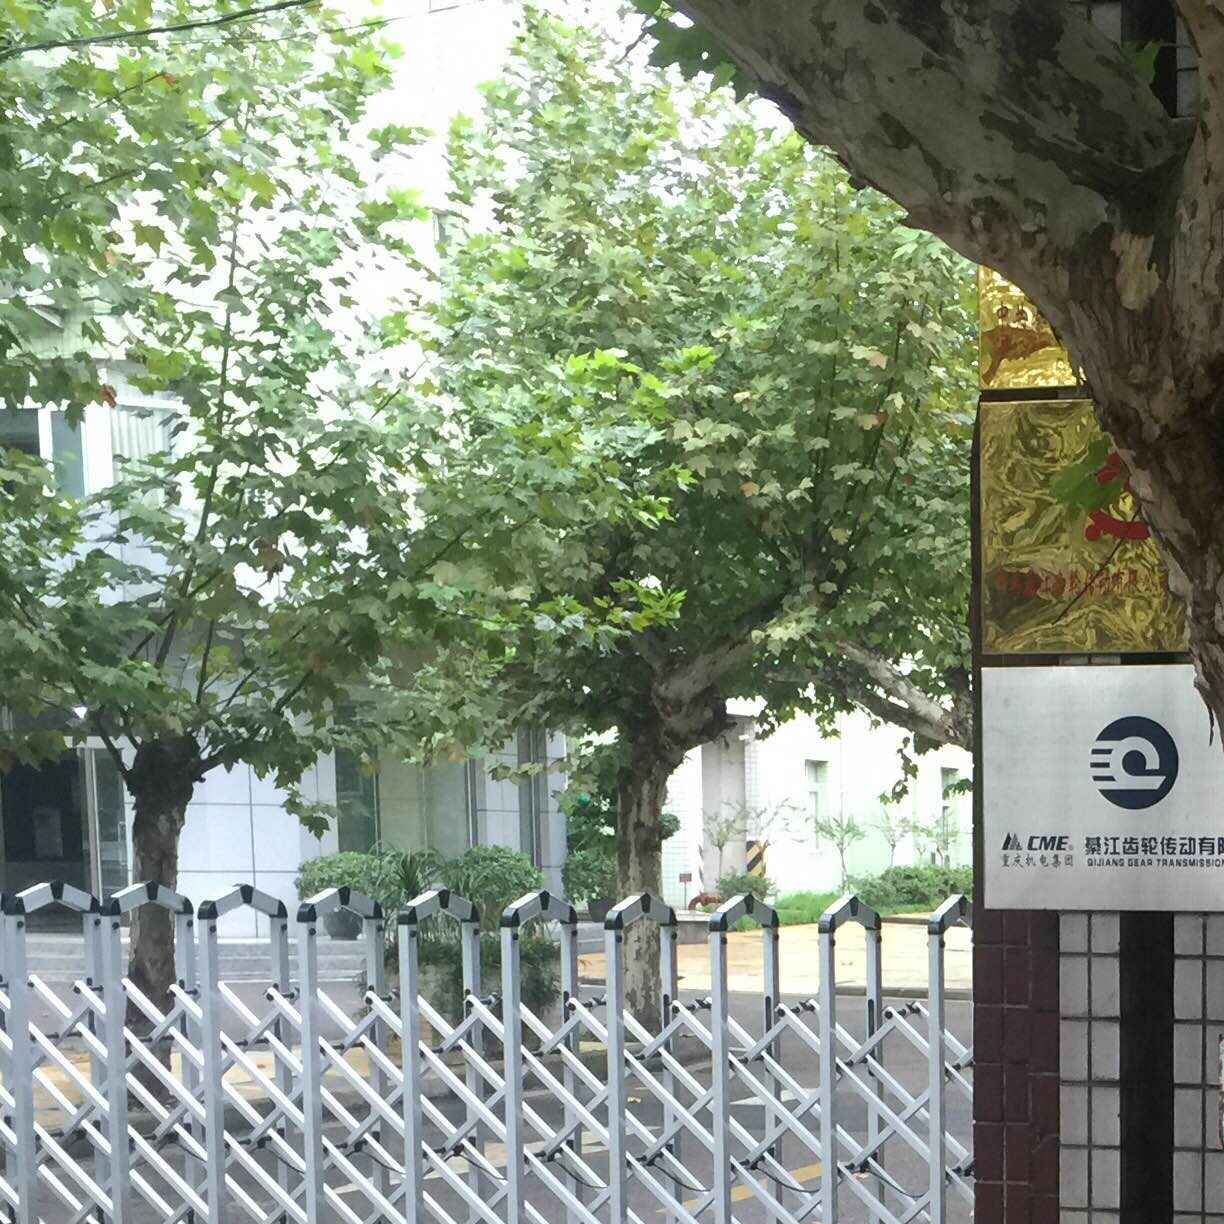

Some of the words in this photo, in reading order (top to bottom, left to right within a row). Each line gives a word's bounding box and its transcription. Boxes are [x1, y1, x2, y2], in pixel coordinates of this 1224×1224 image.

[1027, 835, 1069, 851] CME
[1087, 858, 1125, 867] QIJIANG
[1128, 858, 1153, 867] GEAR
